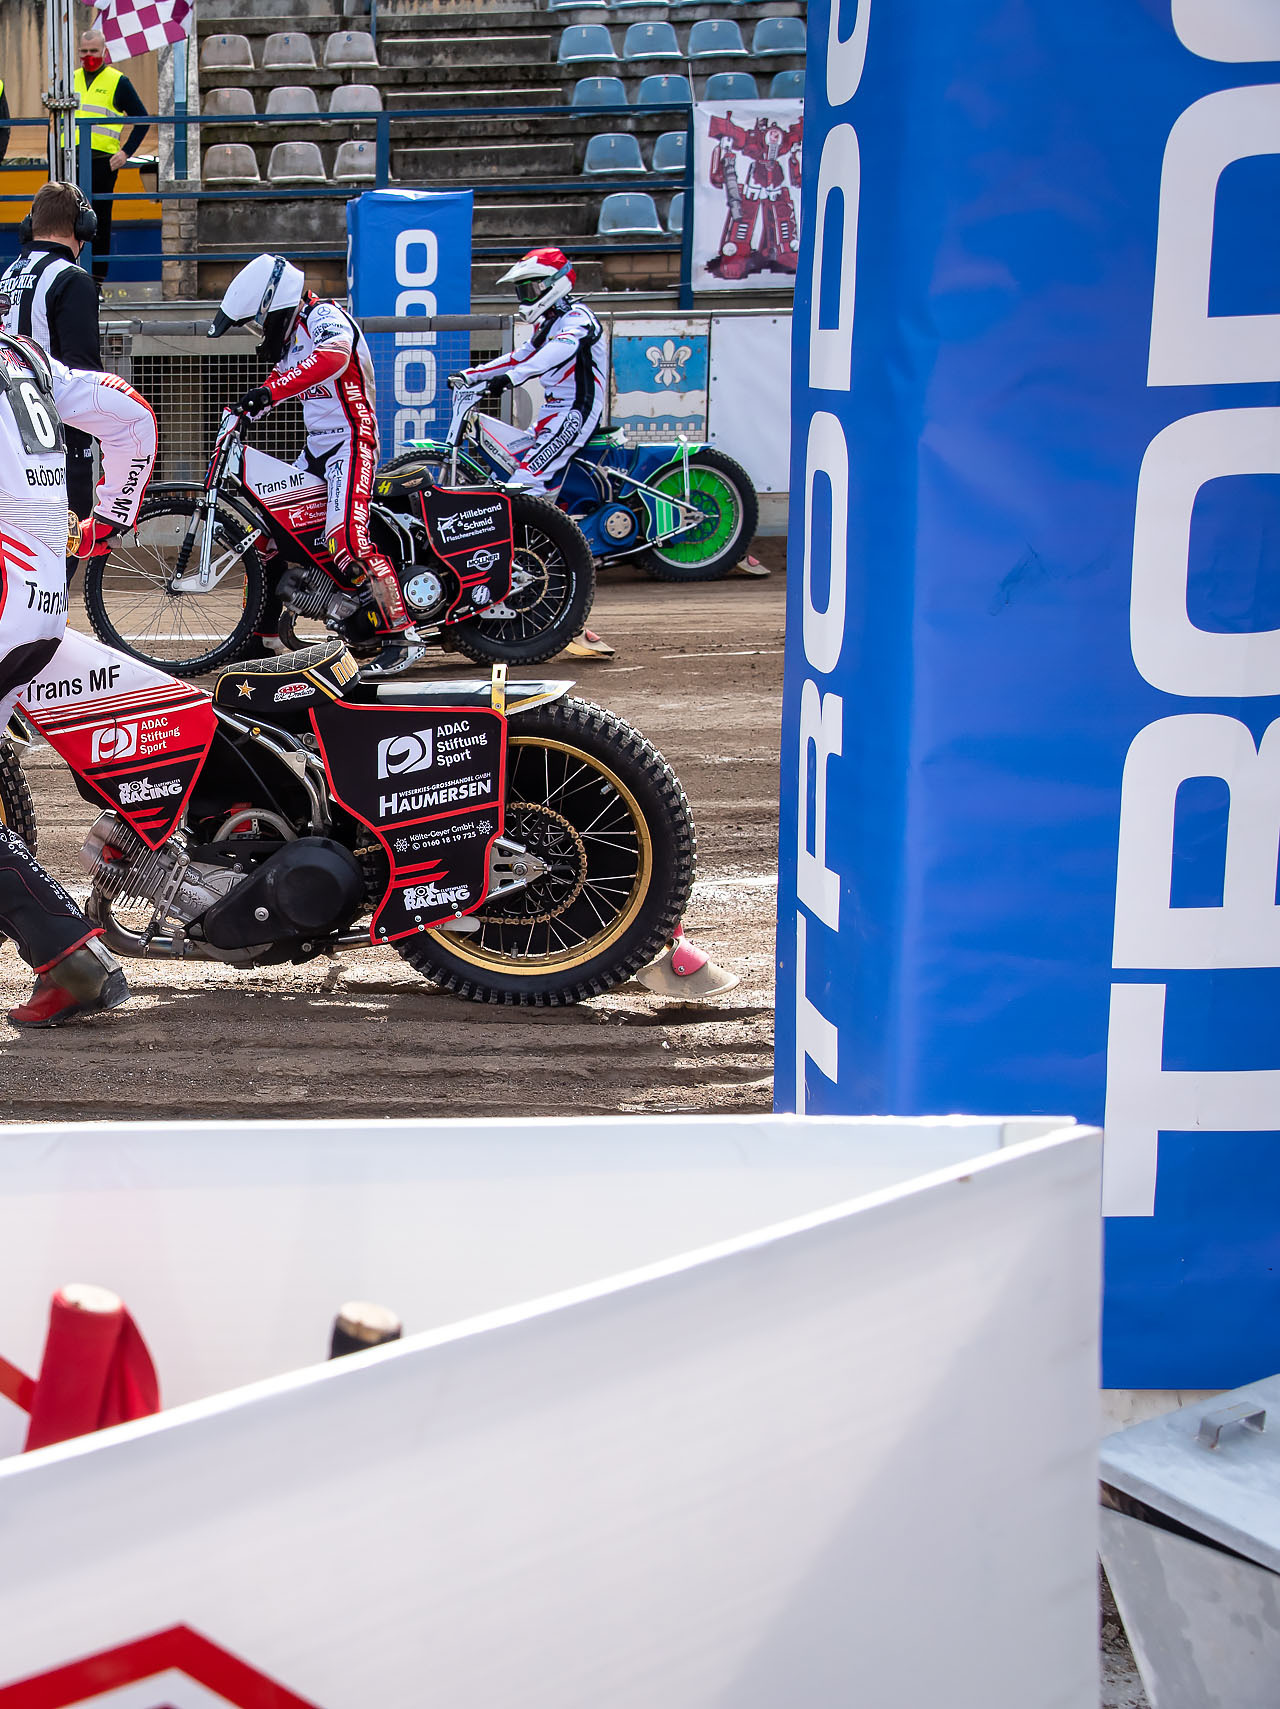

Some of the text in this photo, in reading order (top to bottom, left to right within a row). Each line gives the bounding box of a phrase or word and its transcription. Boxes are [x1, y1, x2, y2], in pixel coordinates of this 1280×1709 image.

[301, 353, 318, 370] MF
[19, 381, 57, 449] 6
[344, 381, 374, 437] Trans MF
[25, 465, 66, 487] BLÖDOR
[255, 472, 305, 496] Trans MF
[356, 460, 373, 495] Trans
[110, 454, 151, 525] Trans MF
[353, 500, 370, 525] MF
[460, 502, 503, 520] Hillebrand
[463, 516, 493, 531] Schmid
[369, 557, 391, 577] MF
[26, 664, 121, 703] Trans MF
[141, 717, 168, 731] ADAC
[436, 720, 470, 738] ADAC
[140, 726, 181, 743] Stiftung
[436, 732, 488, 753] Stiftung
[140, 740, 167, 755] Sport
[436, 748, 472, 767] Sport
[120, 784, 182, 804] RACING
[379, 779, 492, 818] HAUMERSEN
[451, 821, 475, 833] GmbH
[422, 831, 477, 848] 0160 18 19 725
[404, 886, 470, 911] RACING
